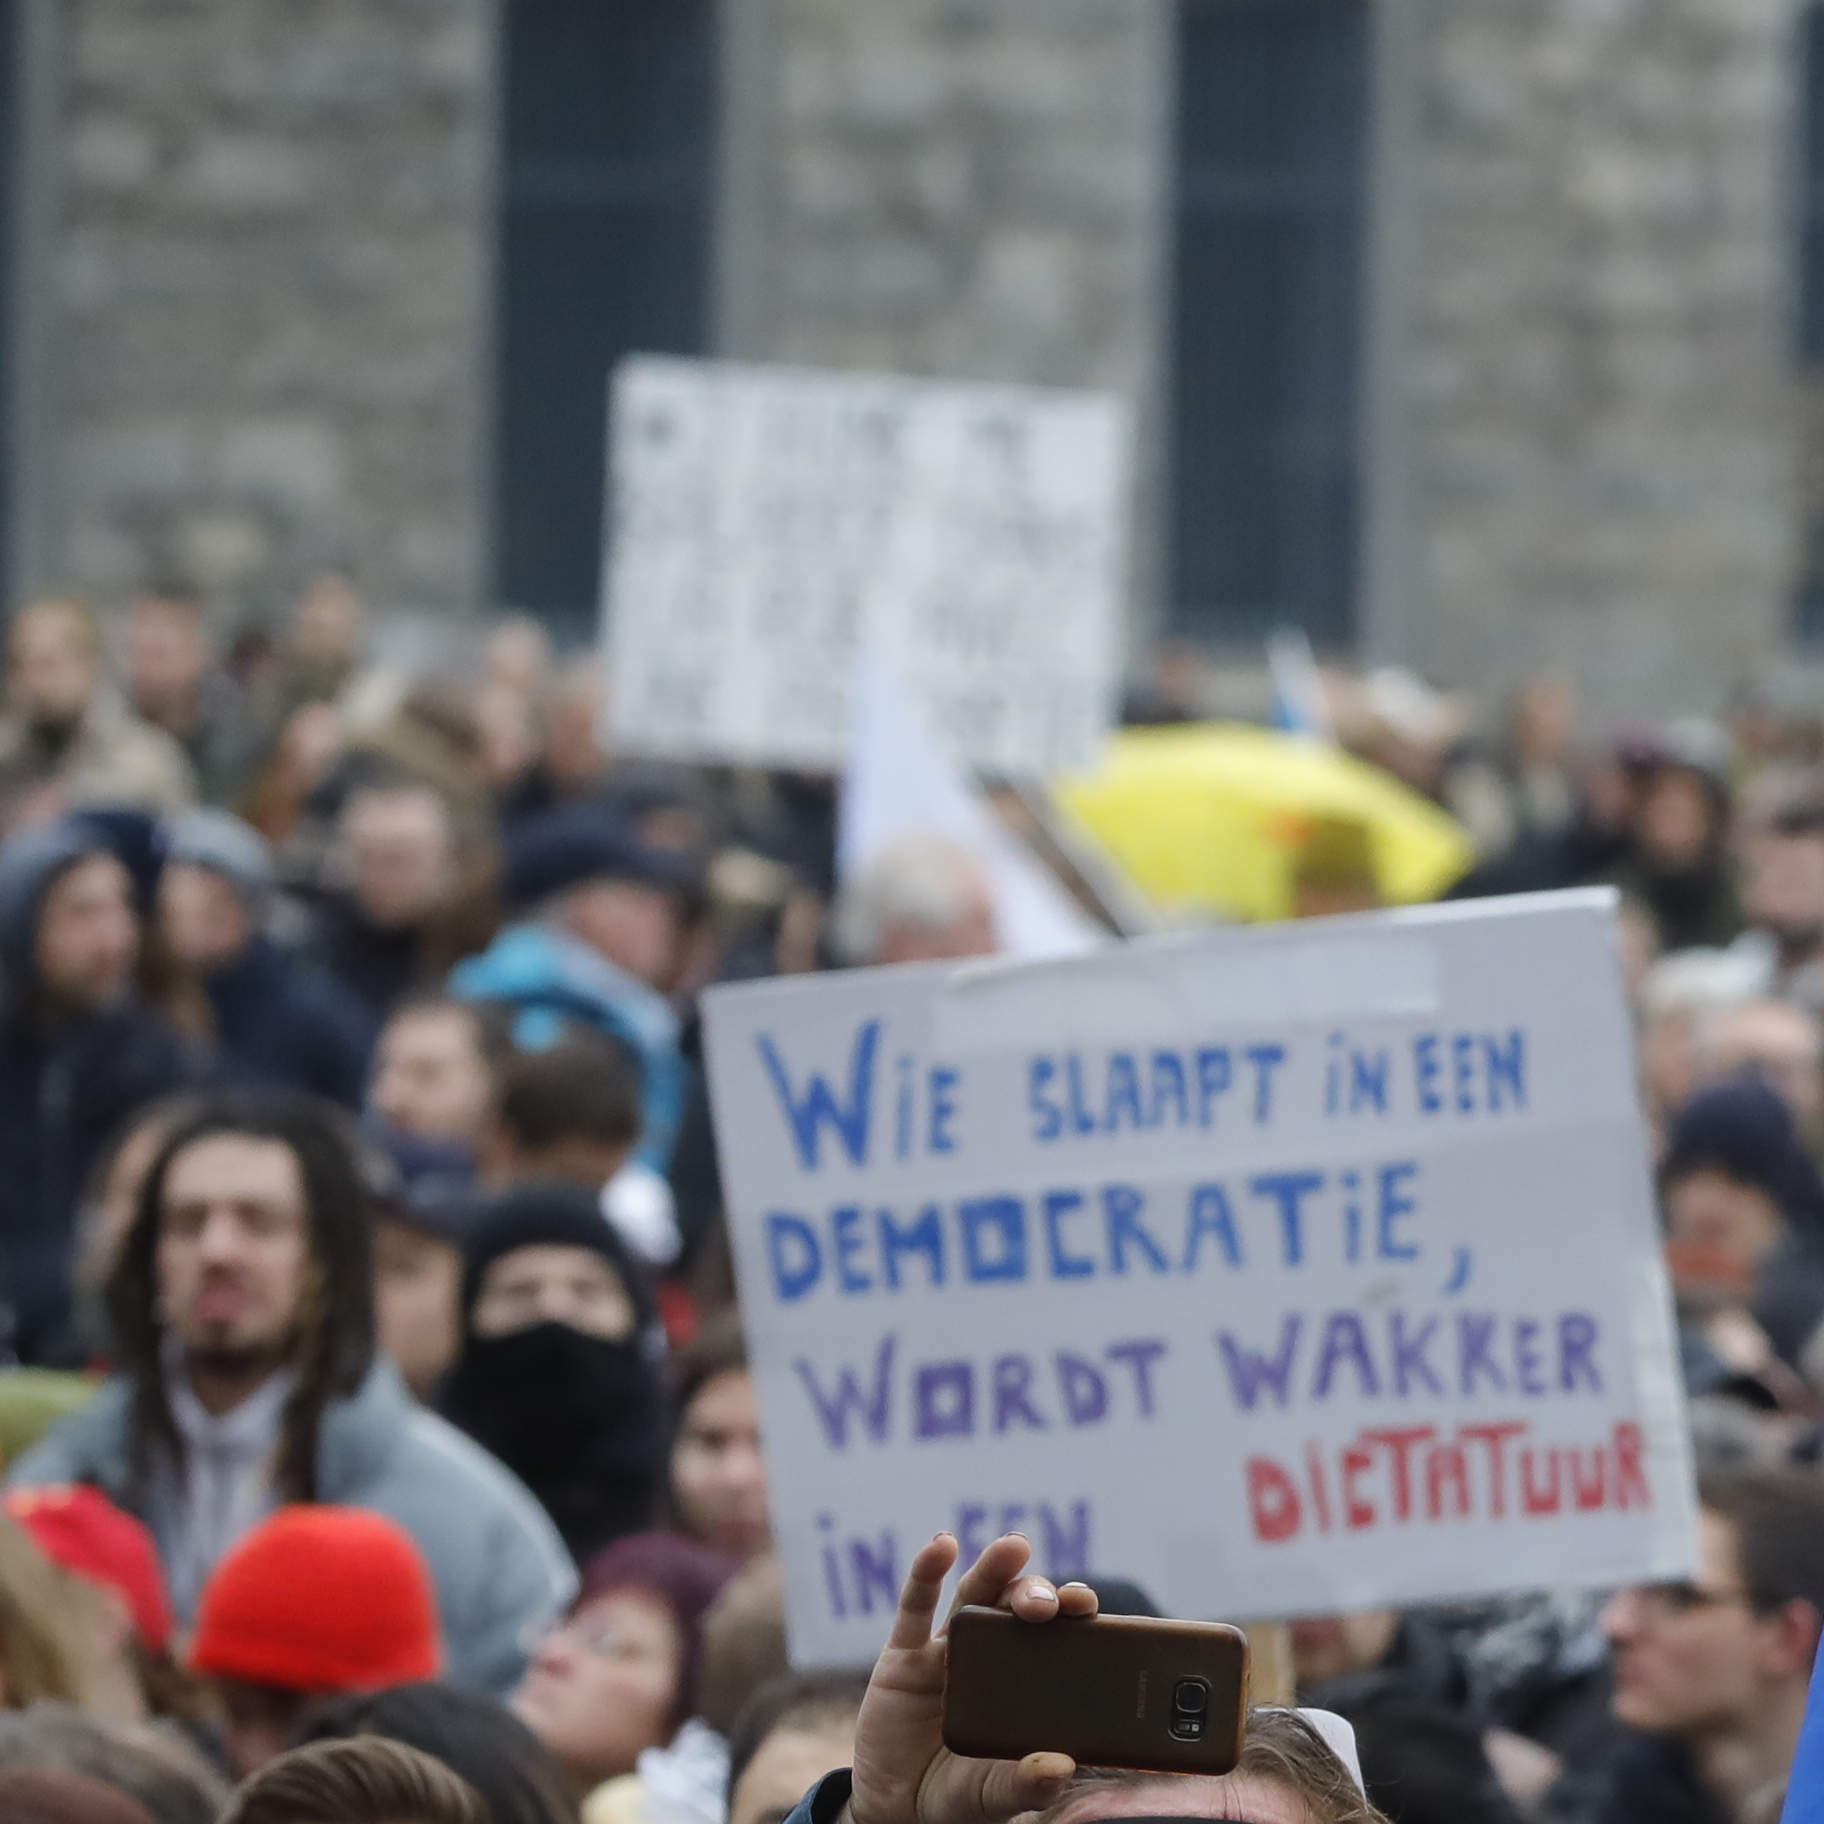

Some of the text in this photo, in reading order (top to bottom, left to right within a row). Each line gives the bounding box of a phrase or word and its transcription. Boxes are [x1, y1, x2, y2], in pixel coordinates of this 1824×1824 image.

[1028, 1044, 1287, 1143] SLAAPT
[1415, 1029, 1528, 1114] EEN
[795, 1311, 1605, 1451] WORDT WAKKER
